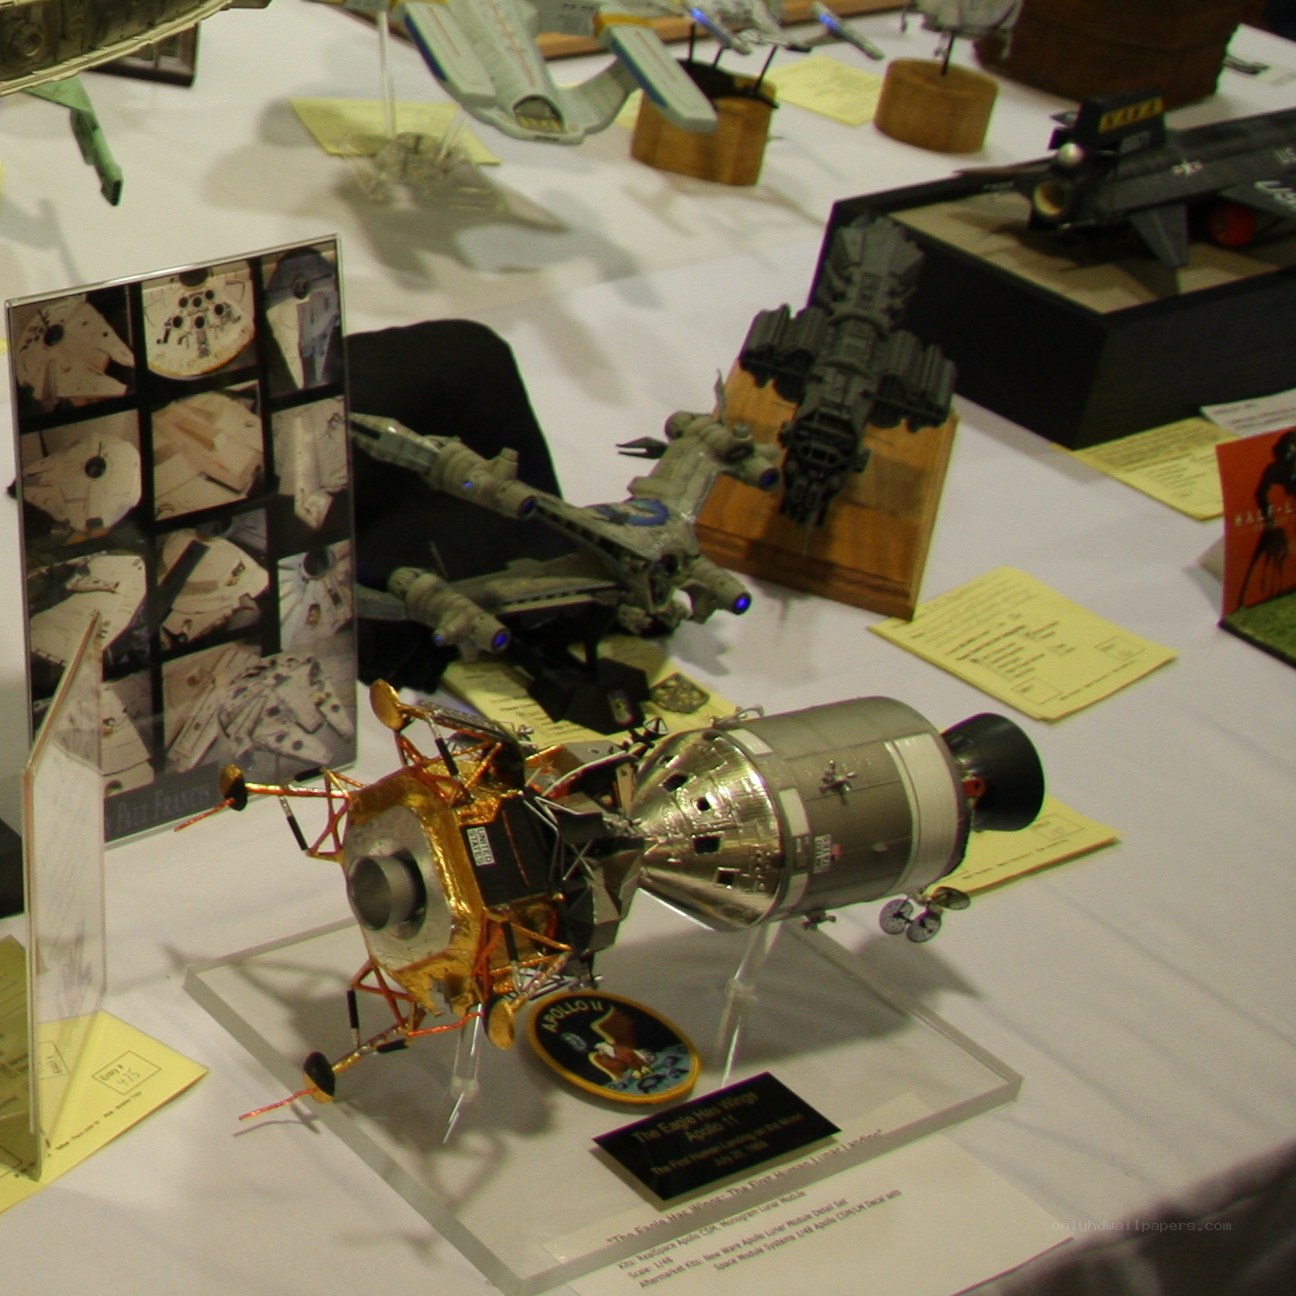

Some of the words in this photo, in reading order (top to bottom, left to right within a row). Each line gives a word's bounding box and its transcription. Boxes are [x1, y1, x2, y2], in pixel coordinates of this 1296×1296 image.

[469, 830, 484, 864] STATES
[478, 828, 492, 863] UNITED
[541, 998, 590, 1033] APOLLO
